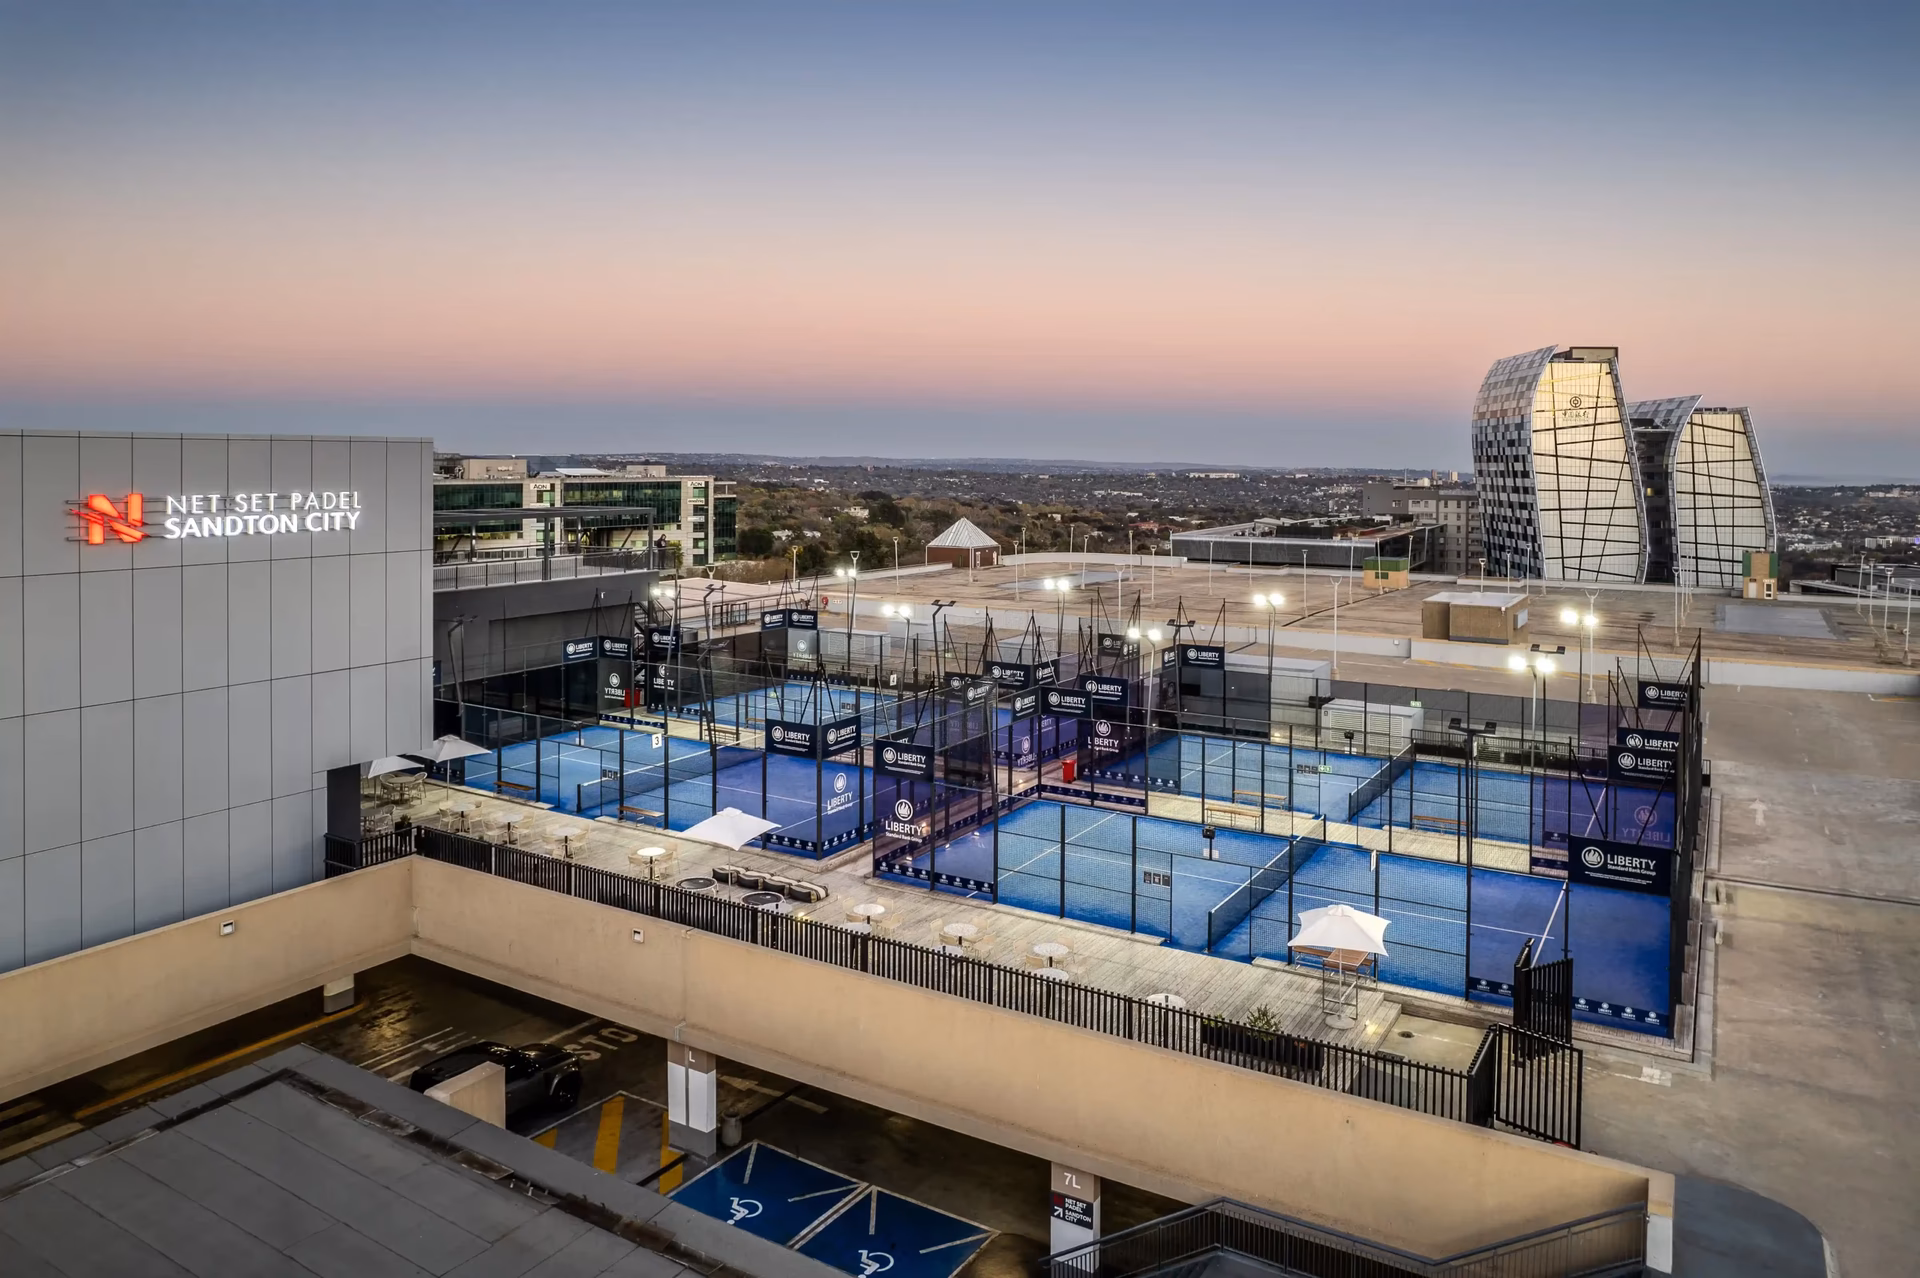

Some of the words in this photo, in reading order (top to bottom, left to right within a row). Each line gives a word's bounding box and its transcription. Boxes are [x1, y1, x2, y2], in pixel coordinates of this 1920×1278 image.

[166, 494, 221, 515] NET
[234, 493, 278, 514] SET
[290, 490, 362, 511] PADEL
[163, 513, 298, 540] SANDTON
[304, 510, 362, 532] CITY
[576, 642, 593, 650] LIBERTY
[653, 677, 674, 686] LIBETY
[1098, 684, 1122, 692] LIBERTY
[1022, 695, 1036, 706] LIBERTY
[1061, 696, 1086, 704] LIBERTY
[785, 730, 810, 741] LIBERTY
[837, 725, 856, 737] LIBERTY
[654, 736, 660, 746] 3
[1088, 736, 1119, 747] LBERTY
[897, 752, 926, 763] LIBERTY
[827, 791, 853, 811] LIBERTY
[885, 820, 922, 836] LIBERTY
[886, 831, 901, 839] Standard
[911, 836, 923, 844] Group
[1607, 854, 1656, 870] LIBERTY
[1608, 864, 1628, 872] Standard
[1641, 868, 1656, 876] Group
[562, 1027, 638, 1061] STO
[1063, 1172, 1081, 1189] 7L
[1065, 1198, 1076, 1206] NET
[1076, 1201, 1087, 1209] SET
[1065, 1203, 1083, 1213] PADEL
[1065, 1210, 1092, 1223] SANDTON
[1065, 1215, 1078, 1223] CITY
